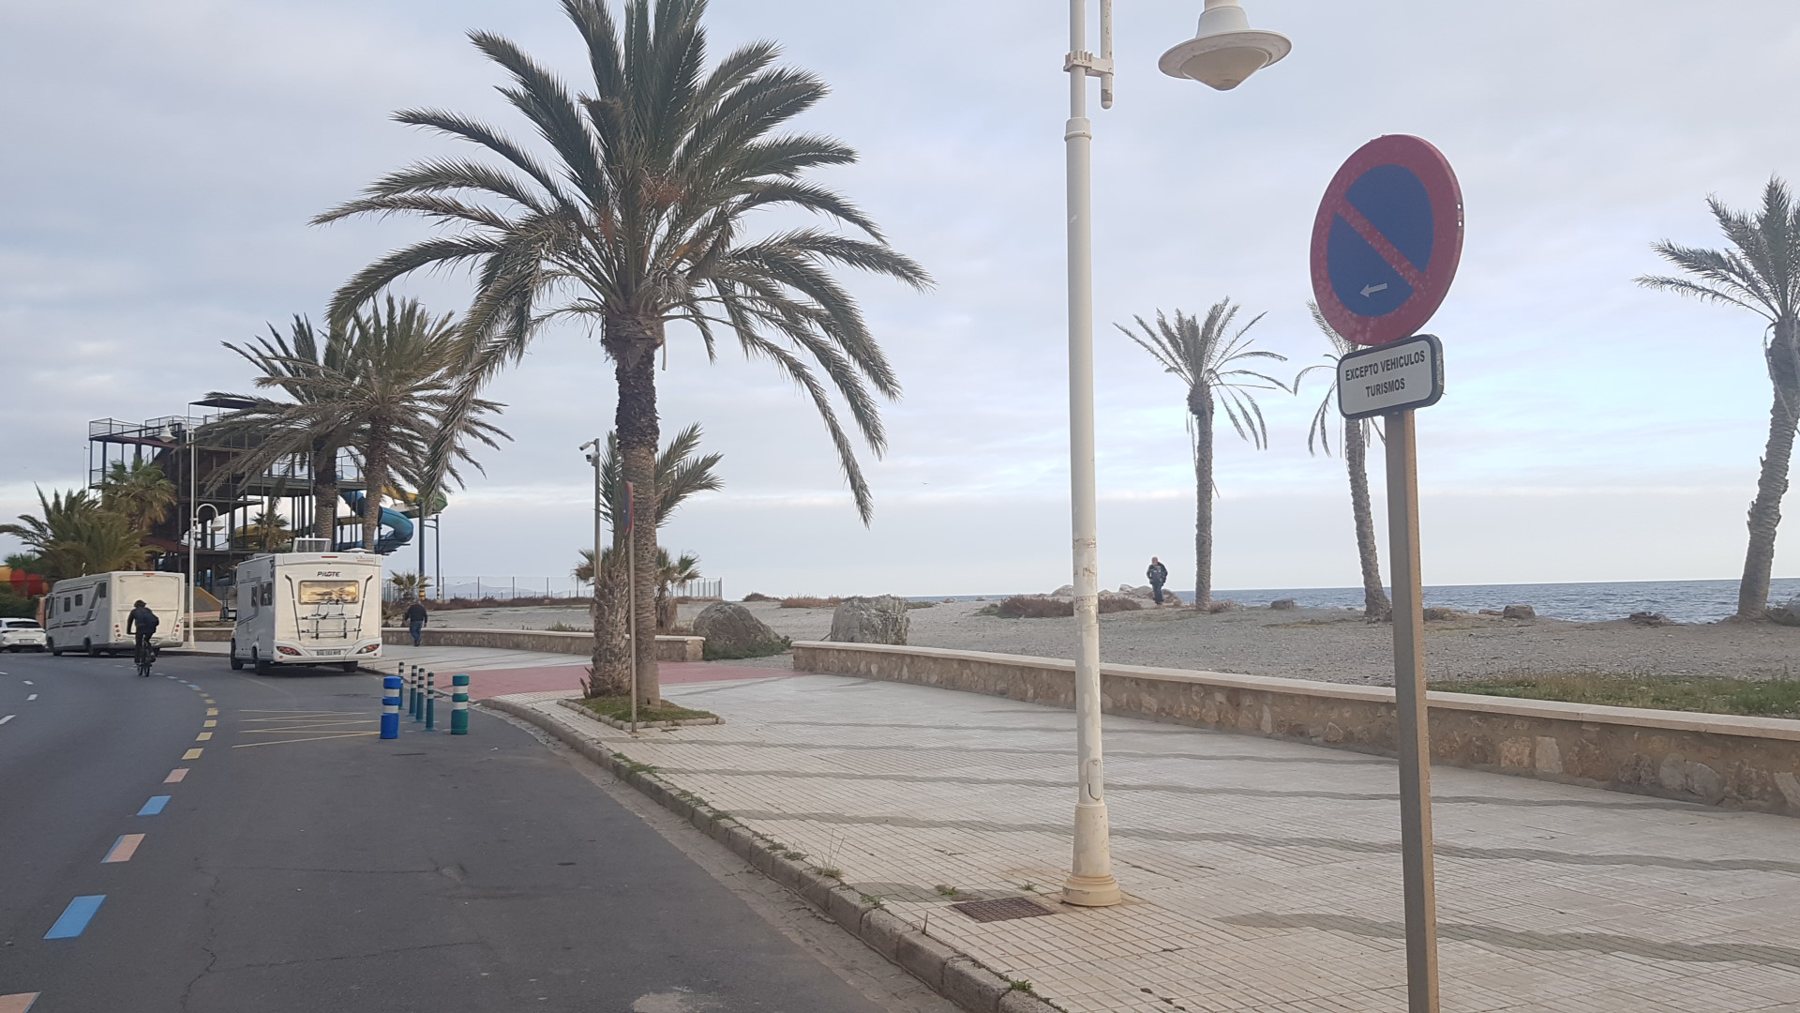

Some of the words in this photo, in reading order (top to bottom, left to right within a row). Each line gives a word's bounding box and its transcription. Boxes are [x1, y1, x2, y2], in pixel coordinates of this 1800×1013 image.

[1345, 362, 1379, 381] EXCEPTO
[1380, 350, 1425, 372] VEHICULOS
[1365, 378, 1405, 398] TURISMOS
